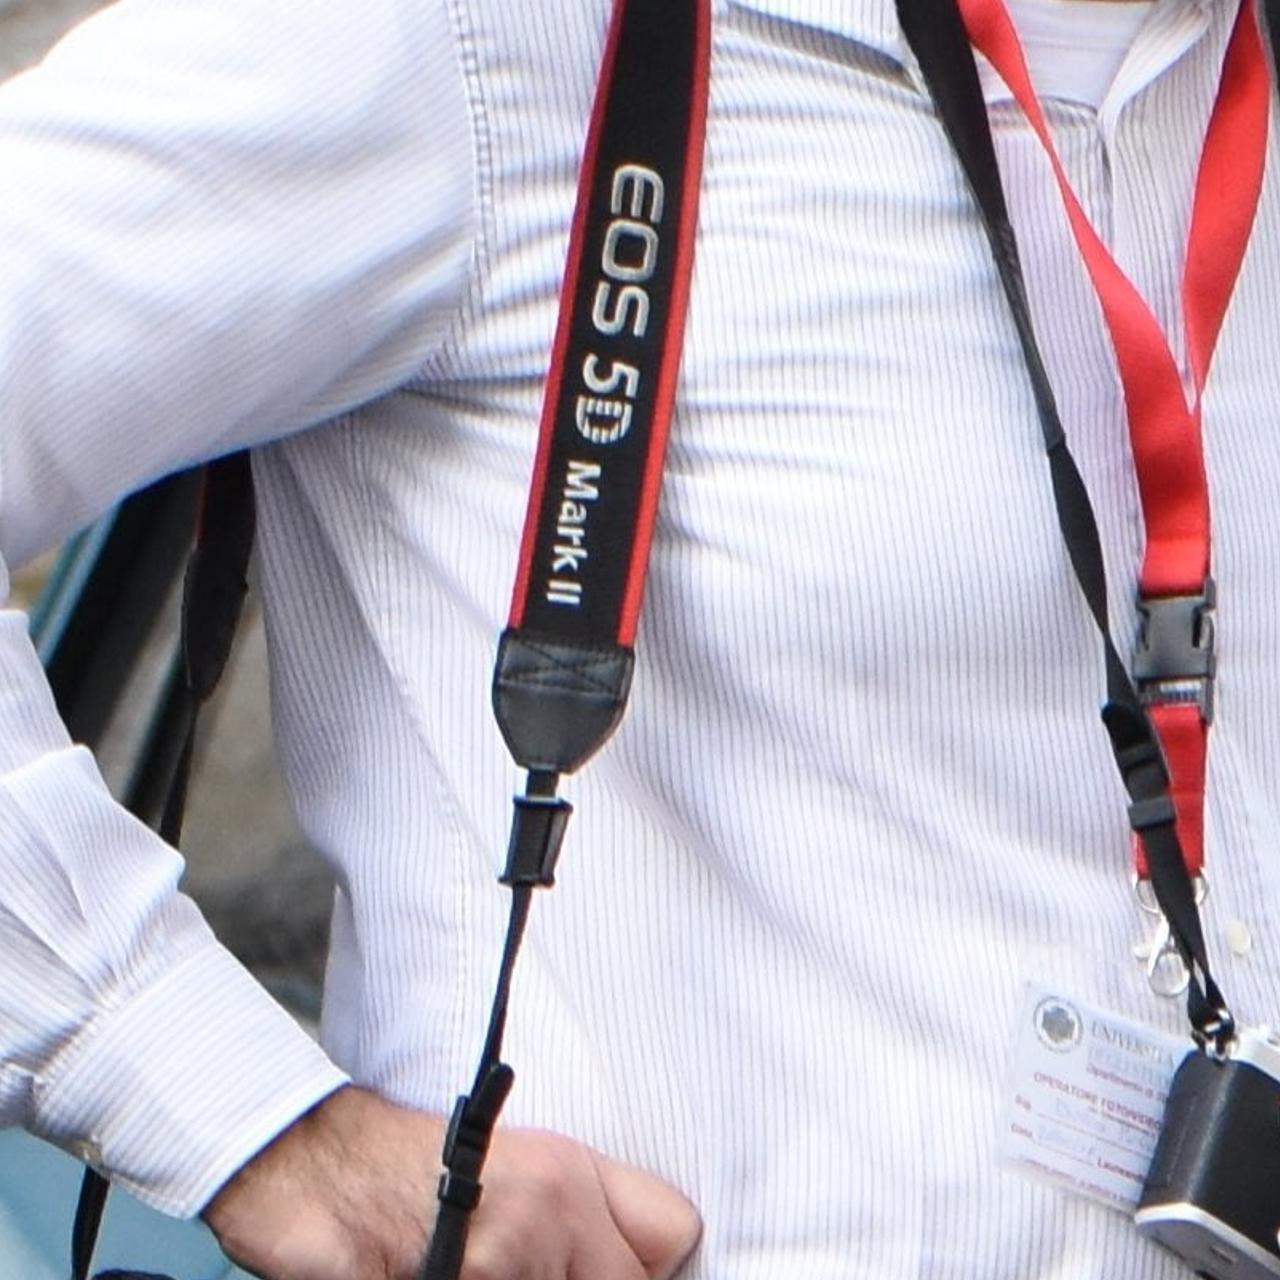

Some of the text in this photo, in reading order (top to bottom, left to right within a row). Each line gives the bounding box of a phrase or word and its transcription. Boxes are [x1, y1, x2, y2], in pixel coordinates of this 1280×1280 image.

[546, 163, 664, 607] EOS 5D Mark II
